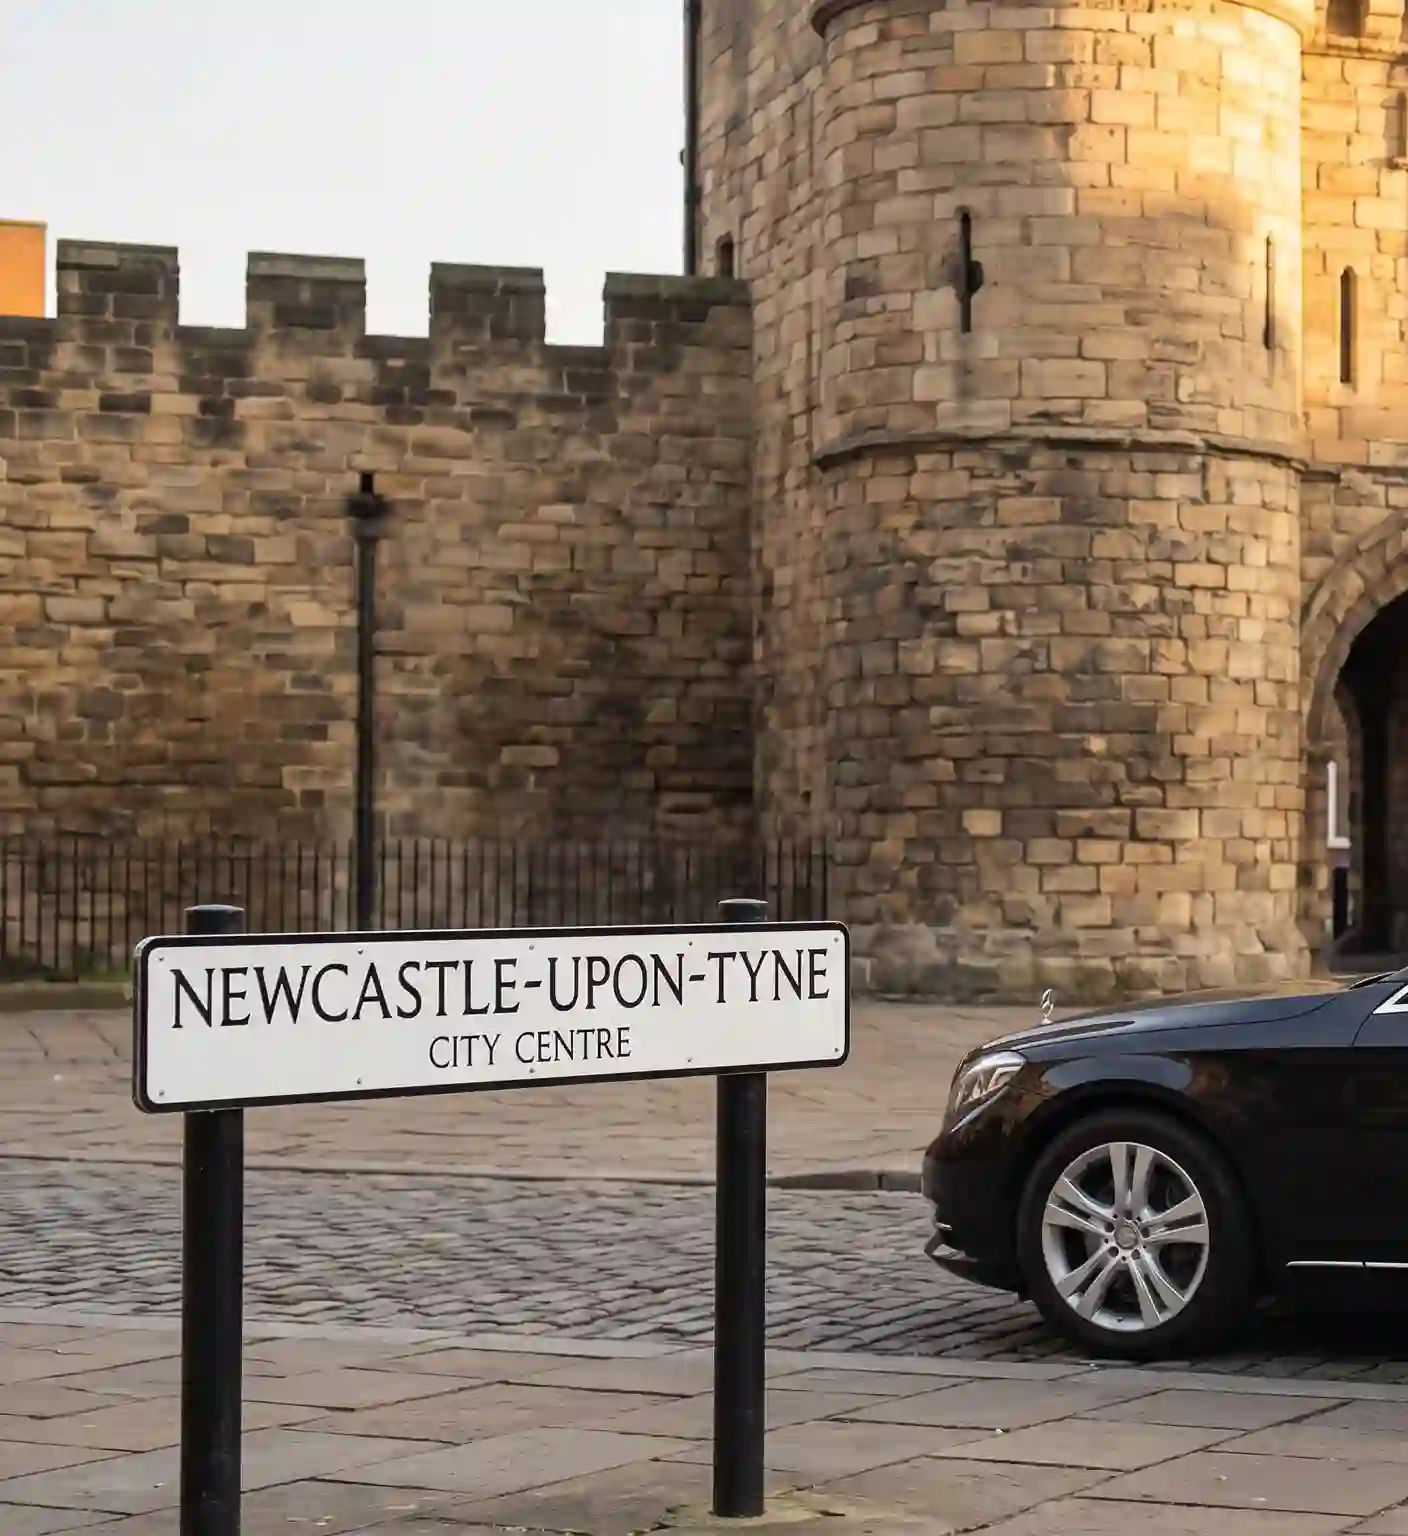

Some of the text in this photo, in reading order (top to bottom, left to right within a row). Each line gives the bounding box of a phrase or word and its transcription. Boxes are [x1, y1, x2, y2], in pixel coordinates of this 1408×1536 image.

[169, 948, 831, 1029] NEWCASTLE-UPON-TYNE
[429, 1026, 632, 1069] CITY CENTRE
